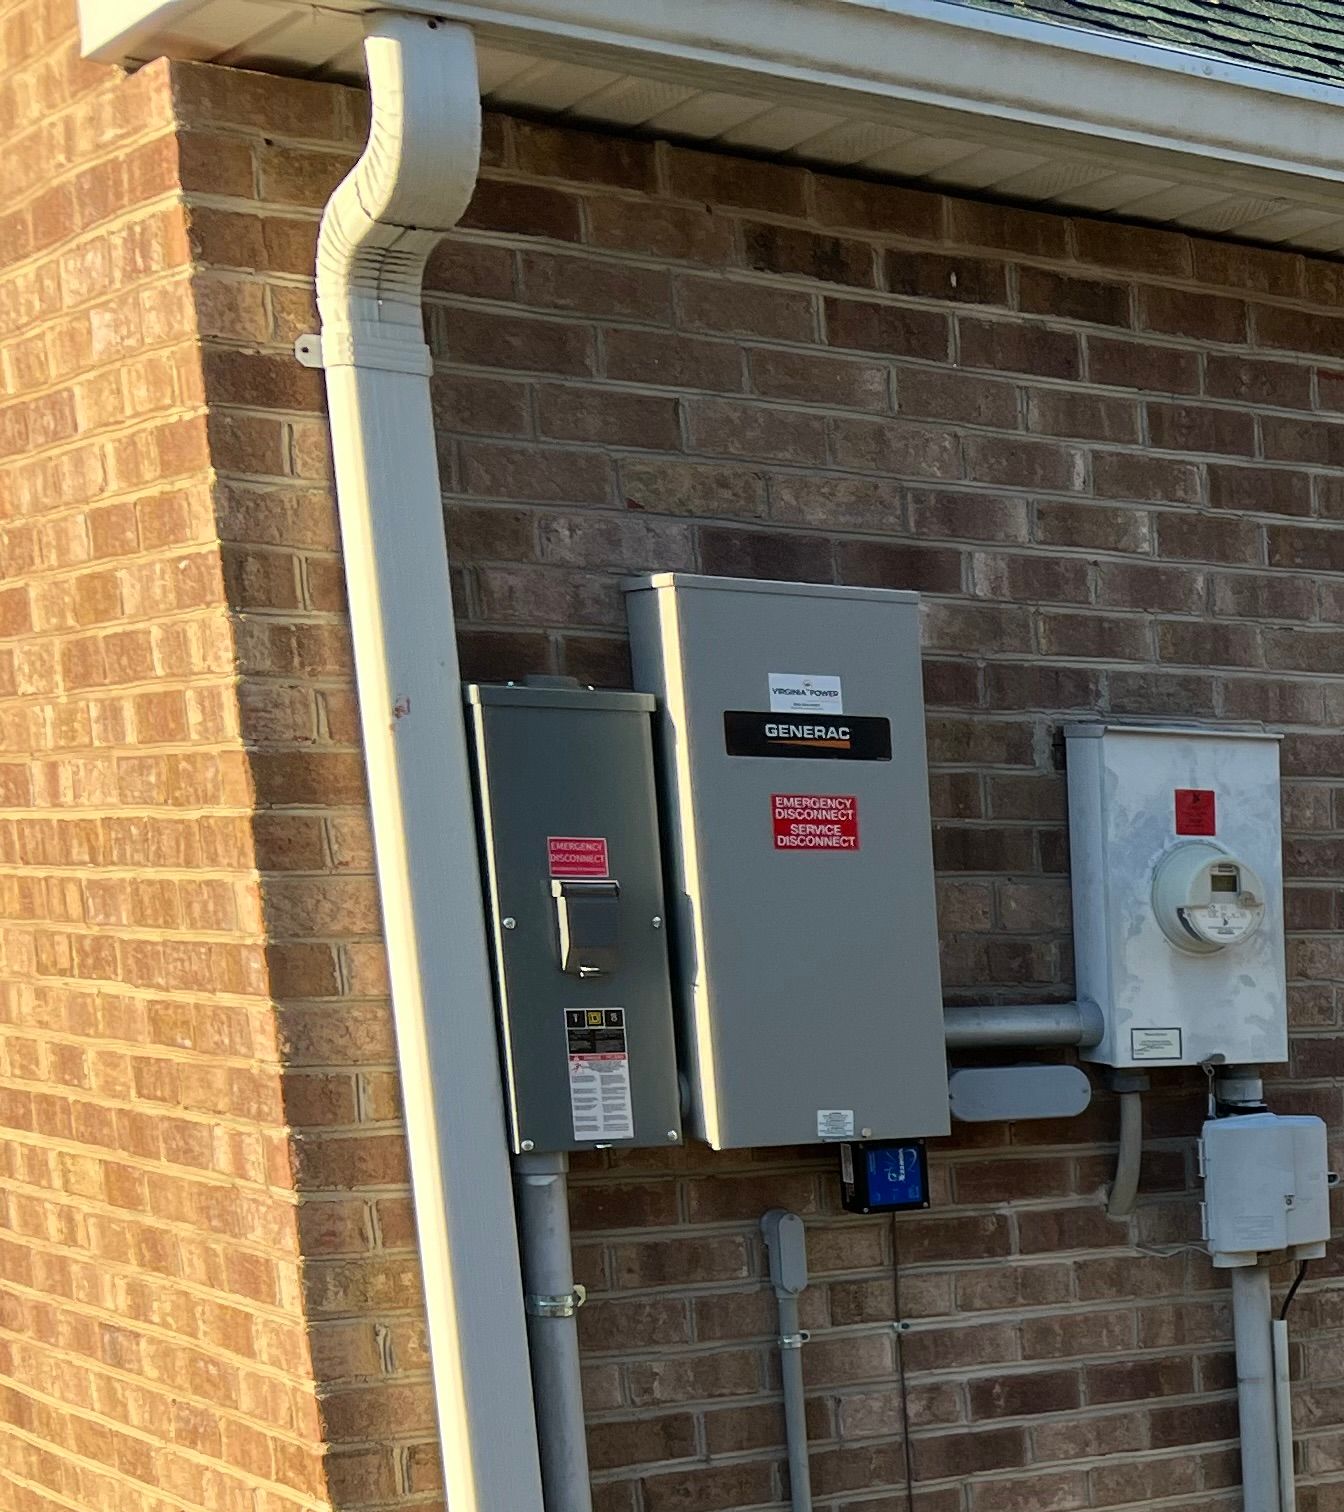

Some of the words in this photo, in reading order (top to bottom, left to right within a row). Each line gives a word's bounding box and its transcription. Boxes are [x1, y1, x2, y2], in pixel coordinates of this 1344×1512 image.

[765, 723, 850, 739] GENERAC
[776, 796, 852, 809] EMERGENCY
[776, 808, 853, 820] DISCONNECT
[790, 824, 841, 835] SERVICE
[777, 836, 855, 847] DISCONNECT
[550, 853, 605, 863] DISCONNECT
